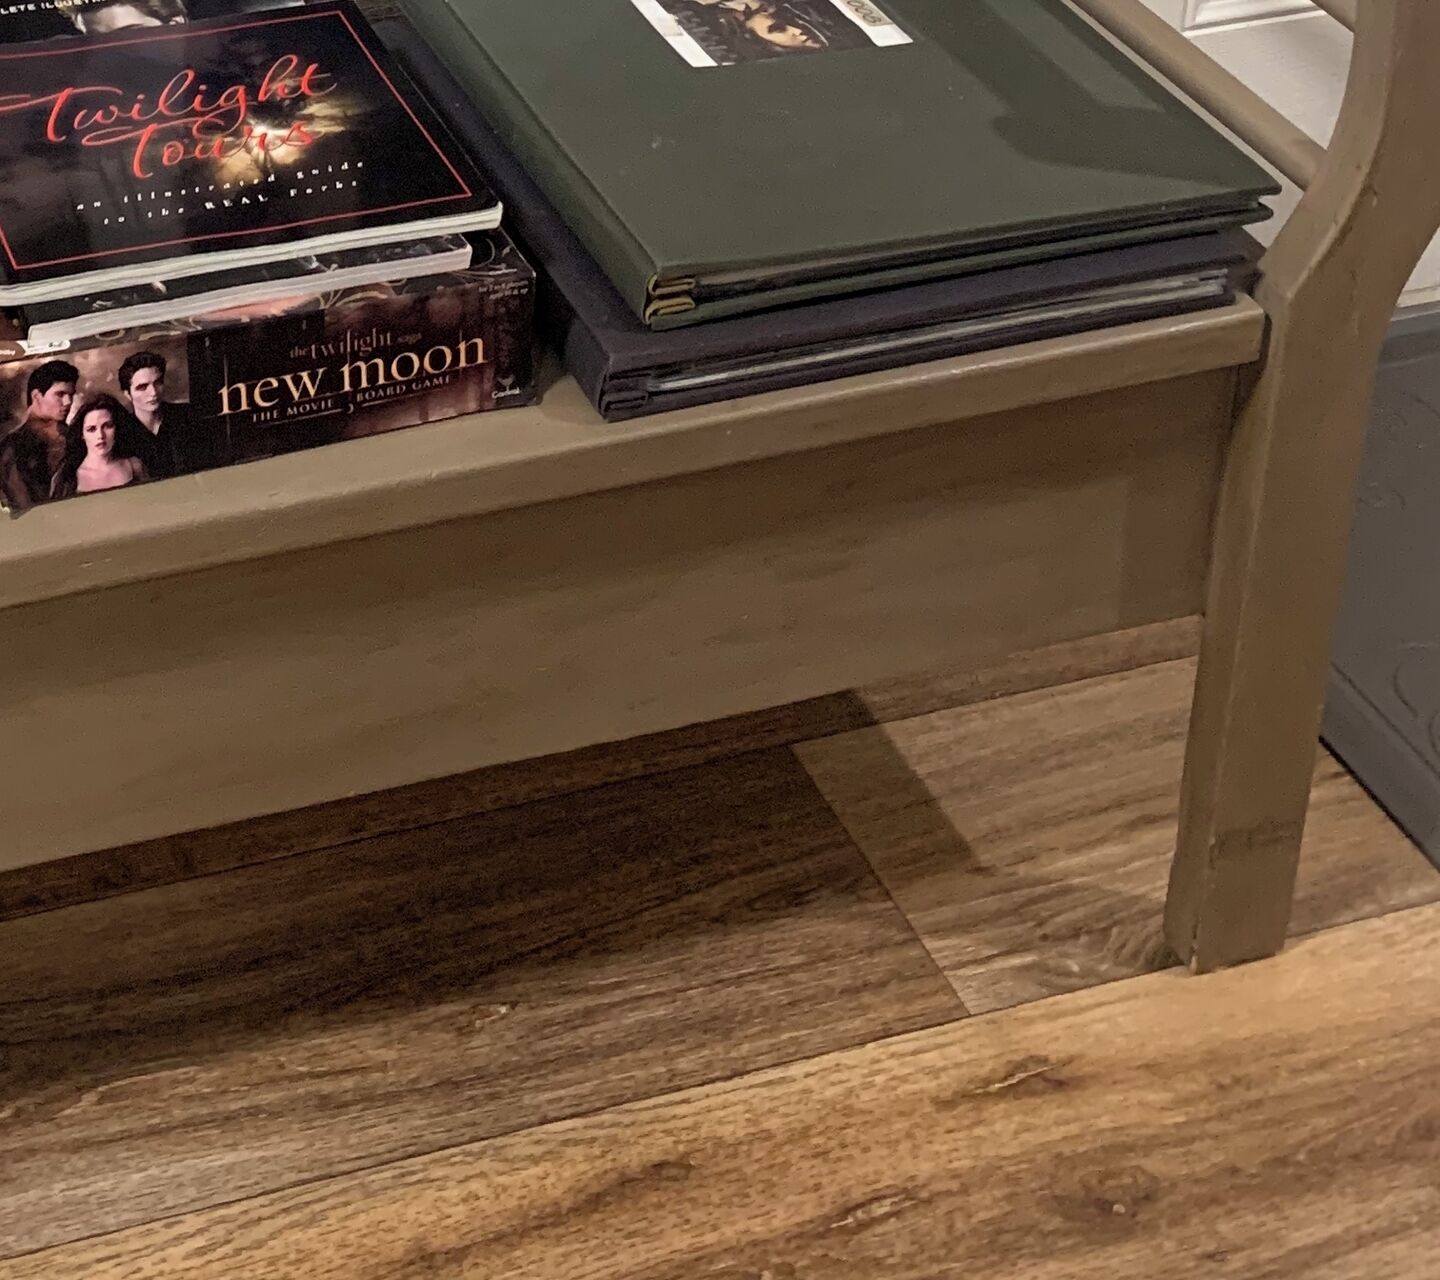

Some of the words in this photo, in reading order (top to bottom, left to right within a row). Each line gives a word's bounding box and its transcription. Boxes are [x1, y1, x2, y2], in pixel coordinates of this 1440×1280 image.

[82, 118, 322, 179] Tours
[147, 205, 184, 219] the
[204, 192, 269, 211] REAL
[289, 344, 309, 358] the
[310, 327, 393, 360] twilight
[217, 366, 329, 417] new
[339, 335, 490, 394] moon
[252, 407, 280, 423] THE
[285, 398, 335, 416] MOVIE
[355, 384, 408, 402] BOARD
[412, 374, 452, 391] GAME
